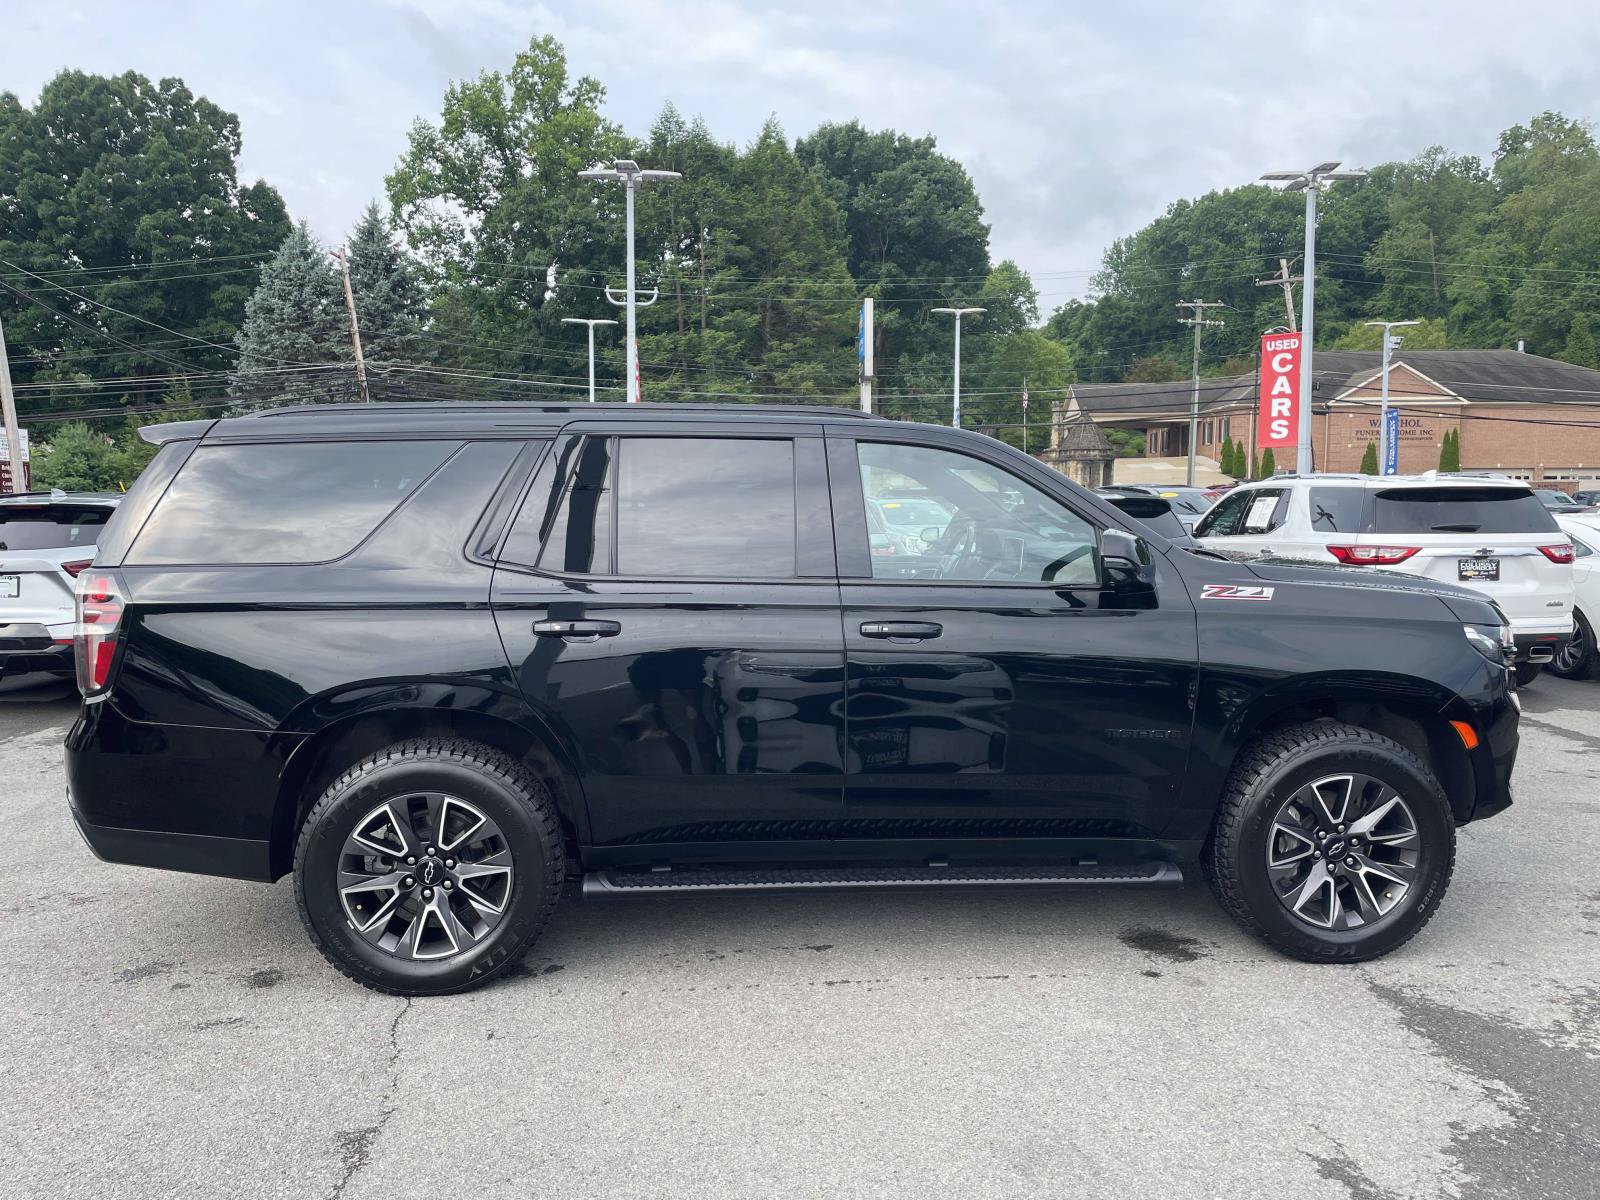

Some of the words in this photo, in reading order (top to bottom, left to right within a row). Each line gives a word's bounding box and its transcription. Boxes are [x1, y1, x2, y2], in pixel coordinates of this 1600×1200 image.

[1266, 338, 1299, 351] USED
[1270, 353, 1293, 439] CARS
[1369, 419, 1424, 428] WHOL
[1200, 584, 1275, 600] Z71
